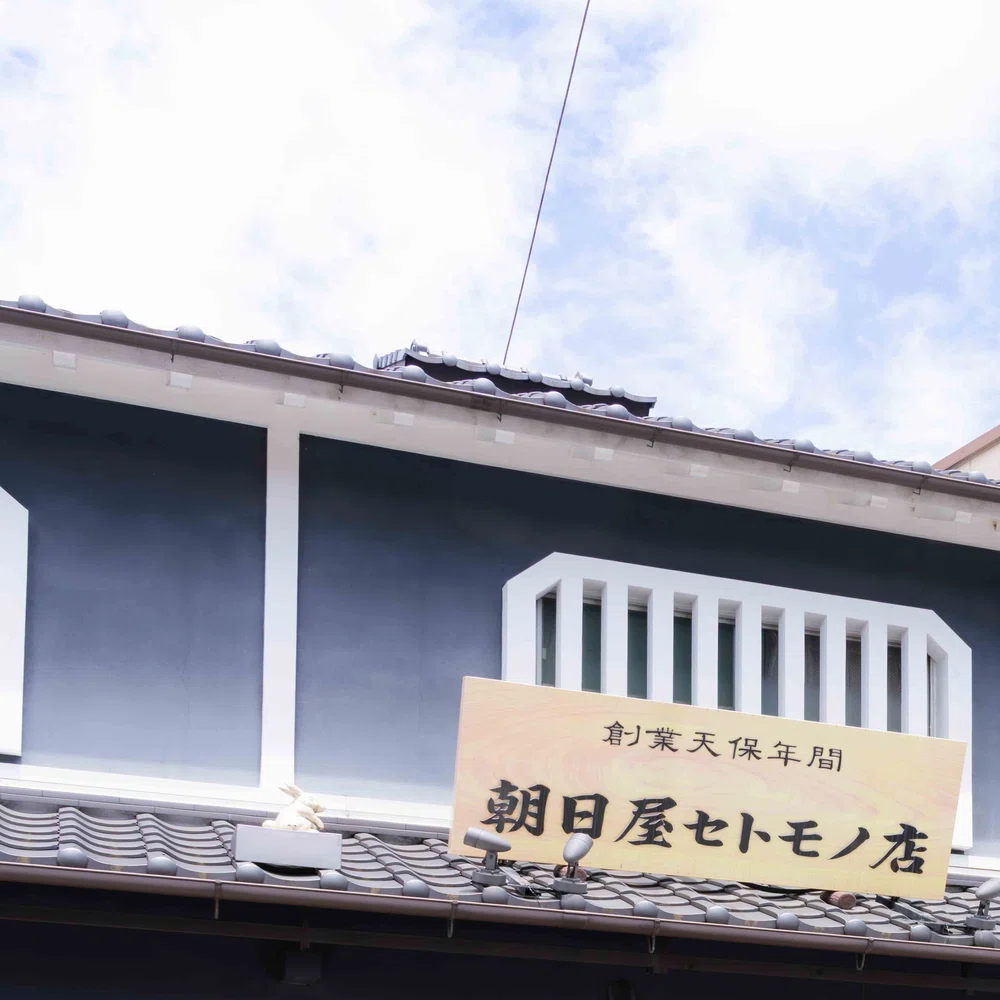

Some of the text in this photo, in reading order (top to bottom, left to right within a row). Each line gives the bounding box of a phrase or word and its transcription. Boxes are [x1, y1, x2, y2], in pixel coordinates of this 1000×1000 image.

[602, 720, 843, 773] 創業天保年間
[480, 779, 929, 875] 朝日屋セトモノ店
